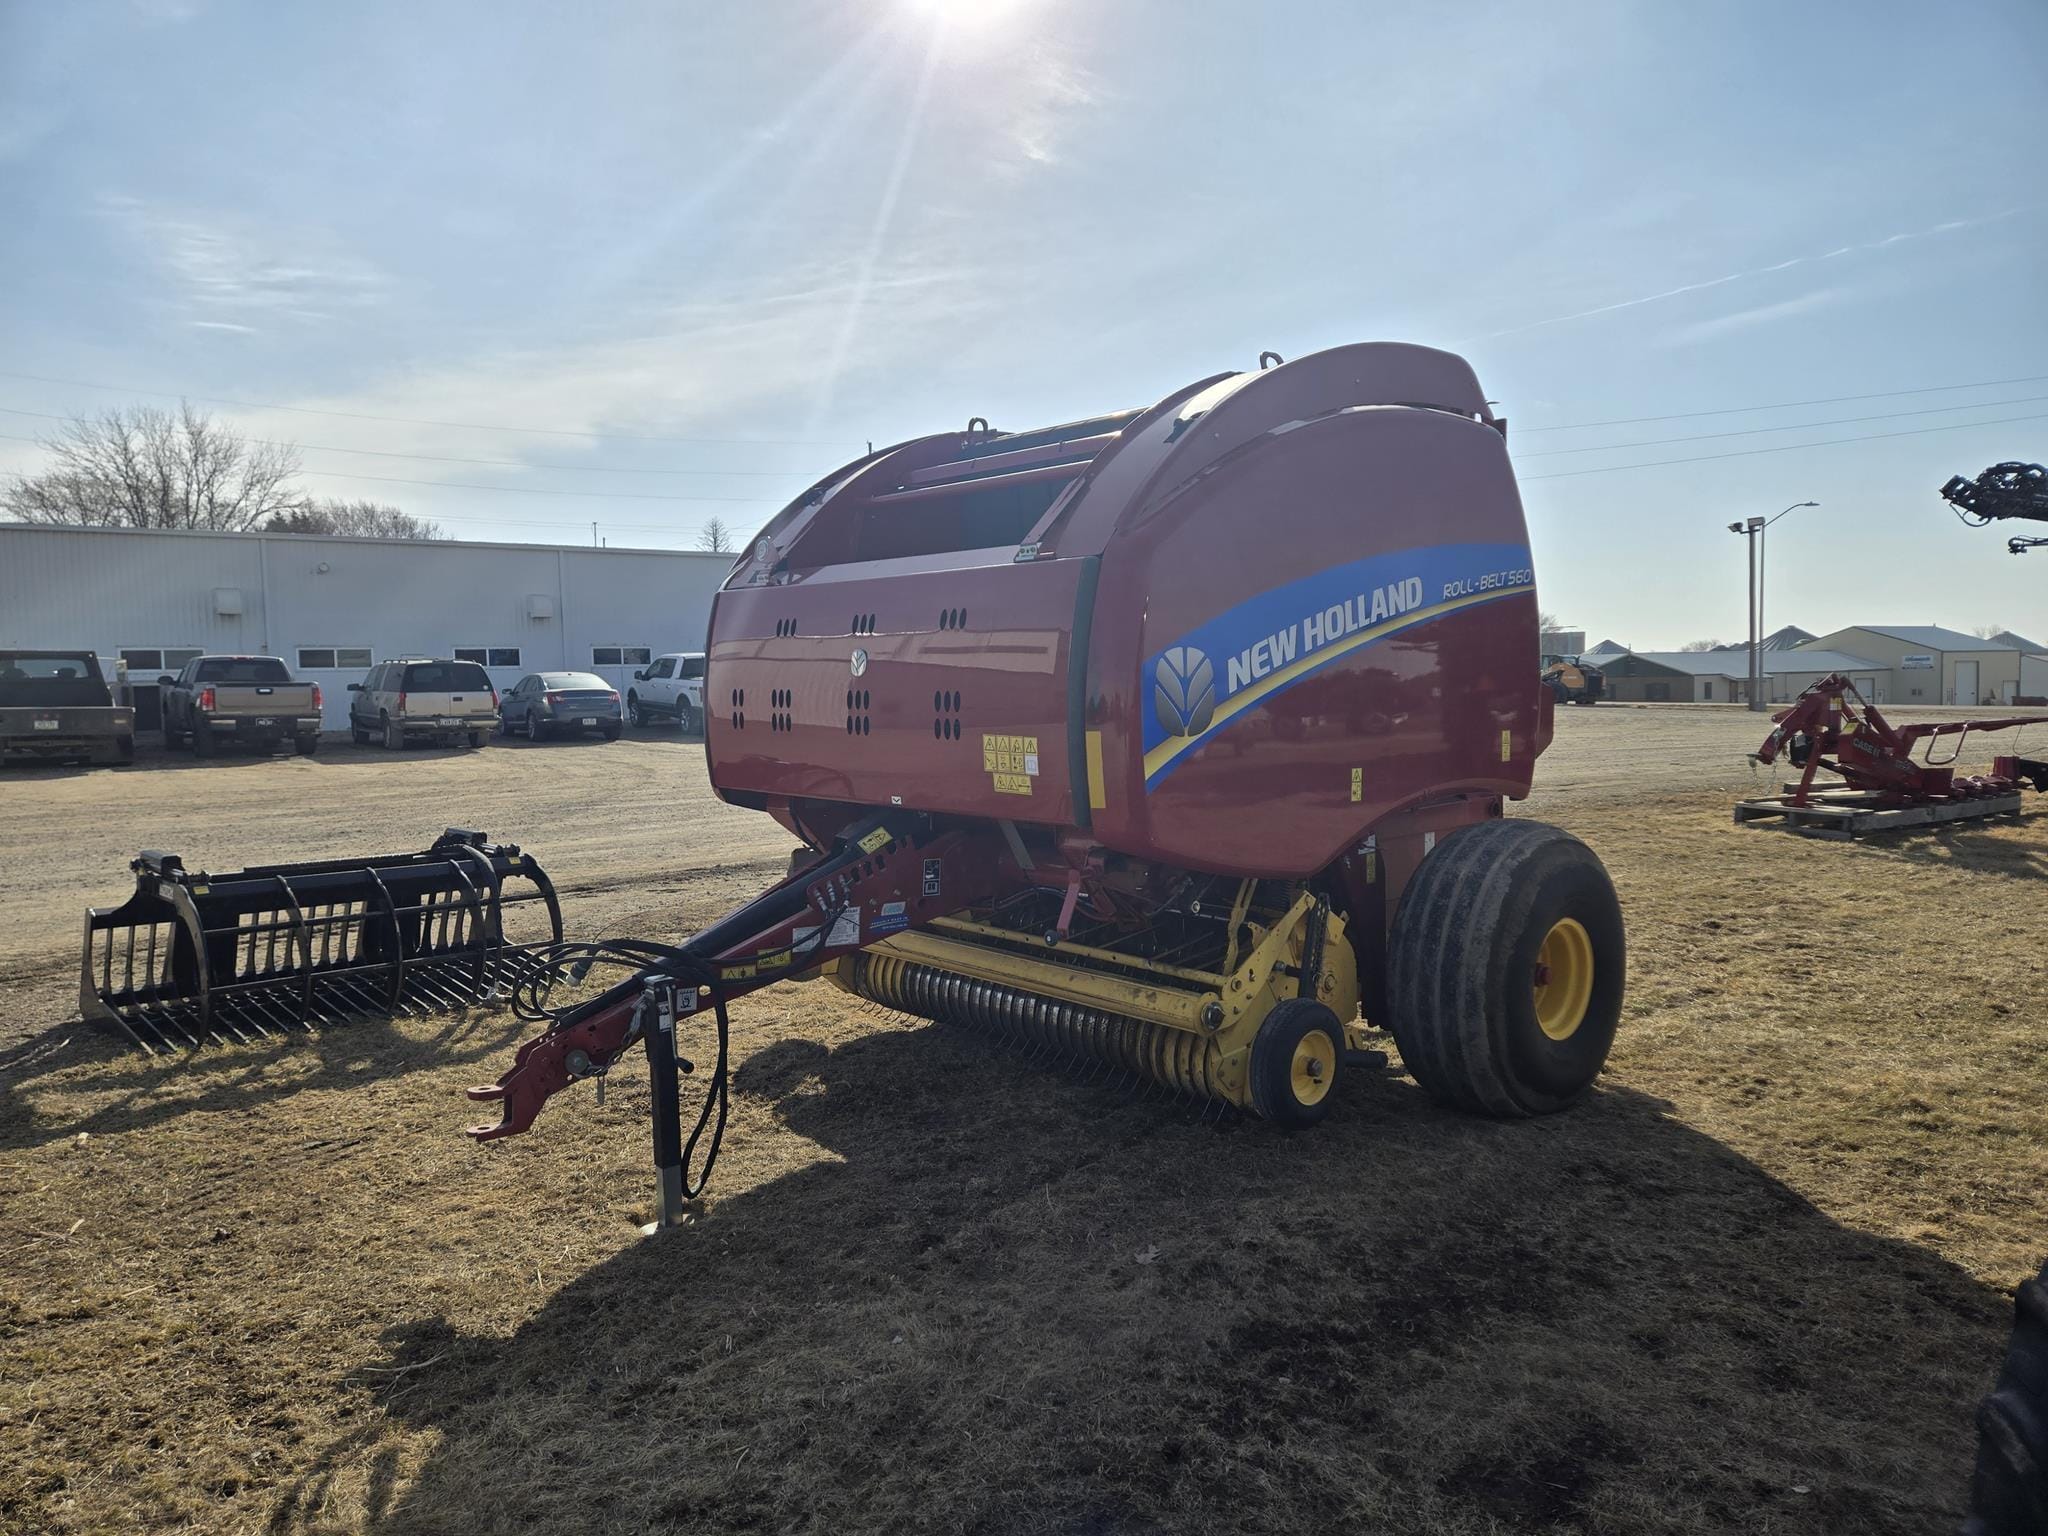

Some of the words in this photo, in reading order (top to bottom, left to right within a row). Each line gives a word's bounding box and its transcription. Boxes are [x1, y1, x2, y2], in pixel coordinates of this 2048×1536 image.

[1443, 572, 1507, 599] ROLL-BELT
[1508, 568, 1532, 585] 560
[1227, 624, 1297, 695] NEW
[1303, 576, 1423, 653] HOLLAND
